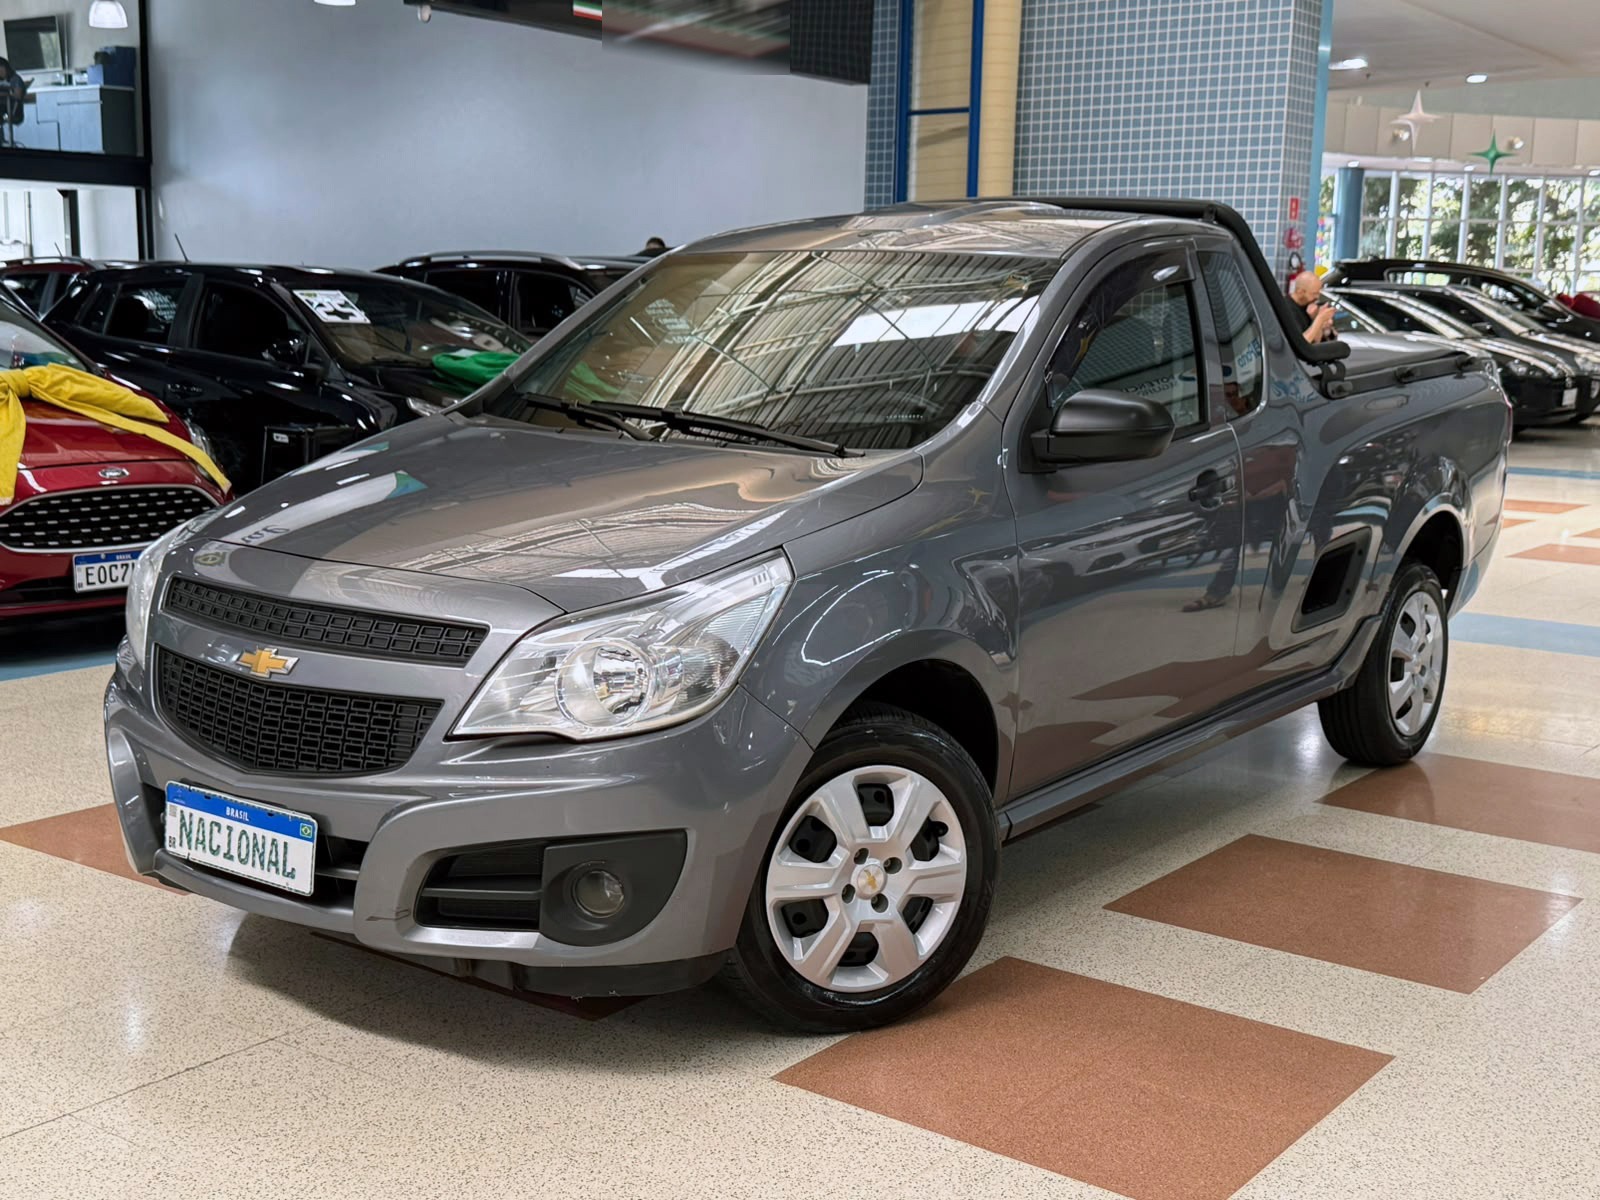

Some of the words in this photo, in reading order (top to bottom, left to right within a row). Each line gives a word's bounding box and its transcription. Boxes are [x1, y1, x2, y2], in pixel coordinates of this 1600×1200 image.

[225, 806, 250, 822] BRASIL
[168, 835, 177, 849] BR
[178, 809, 296, 880] NACIONAL
